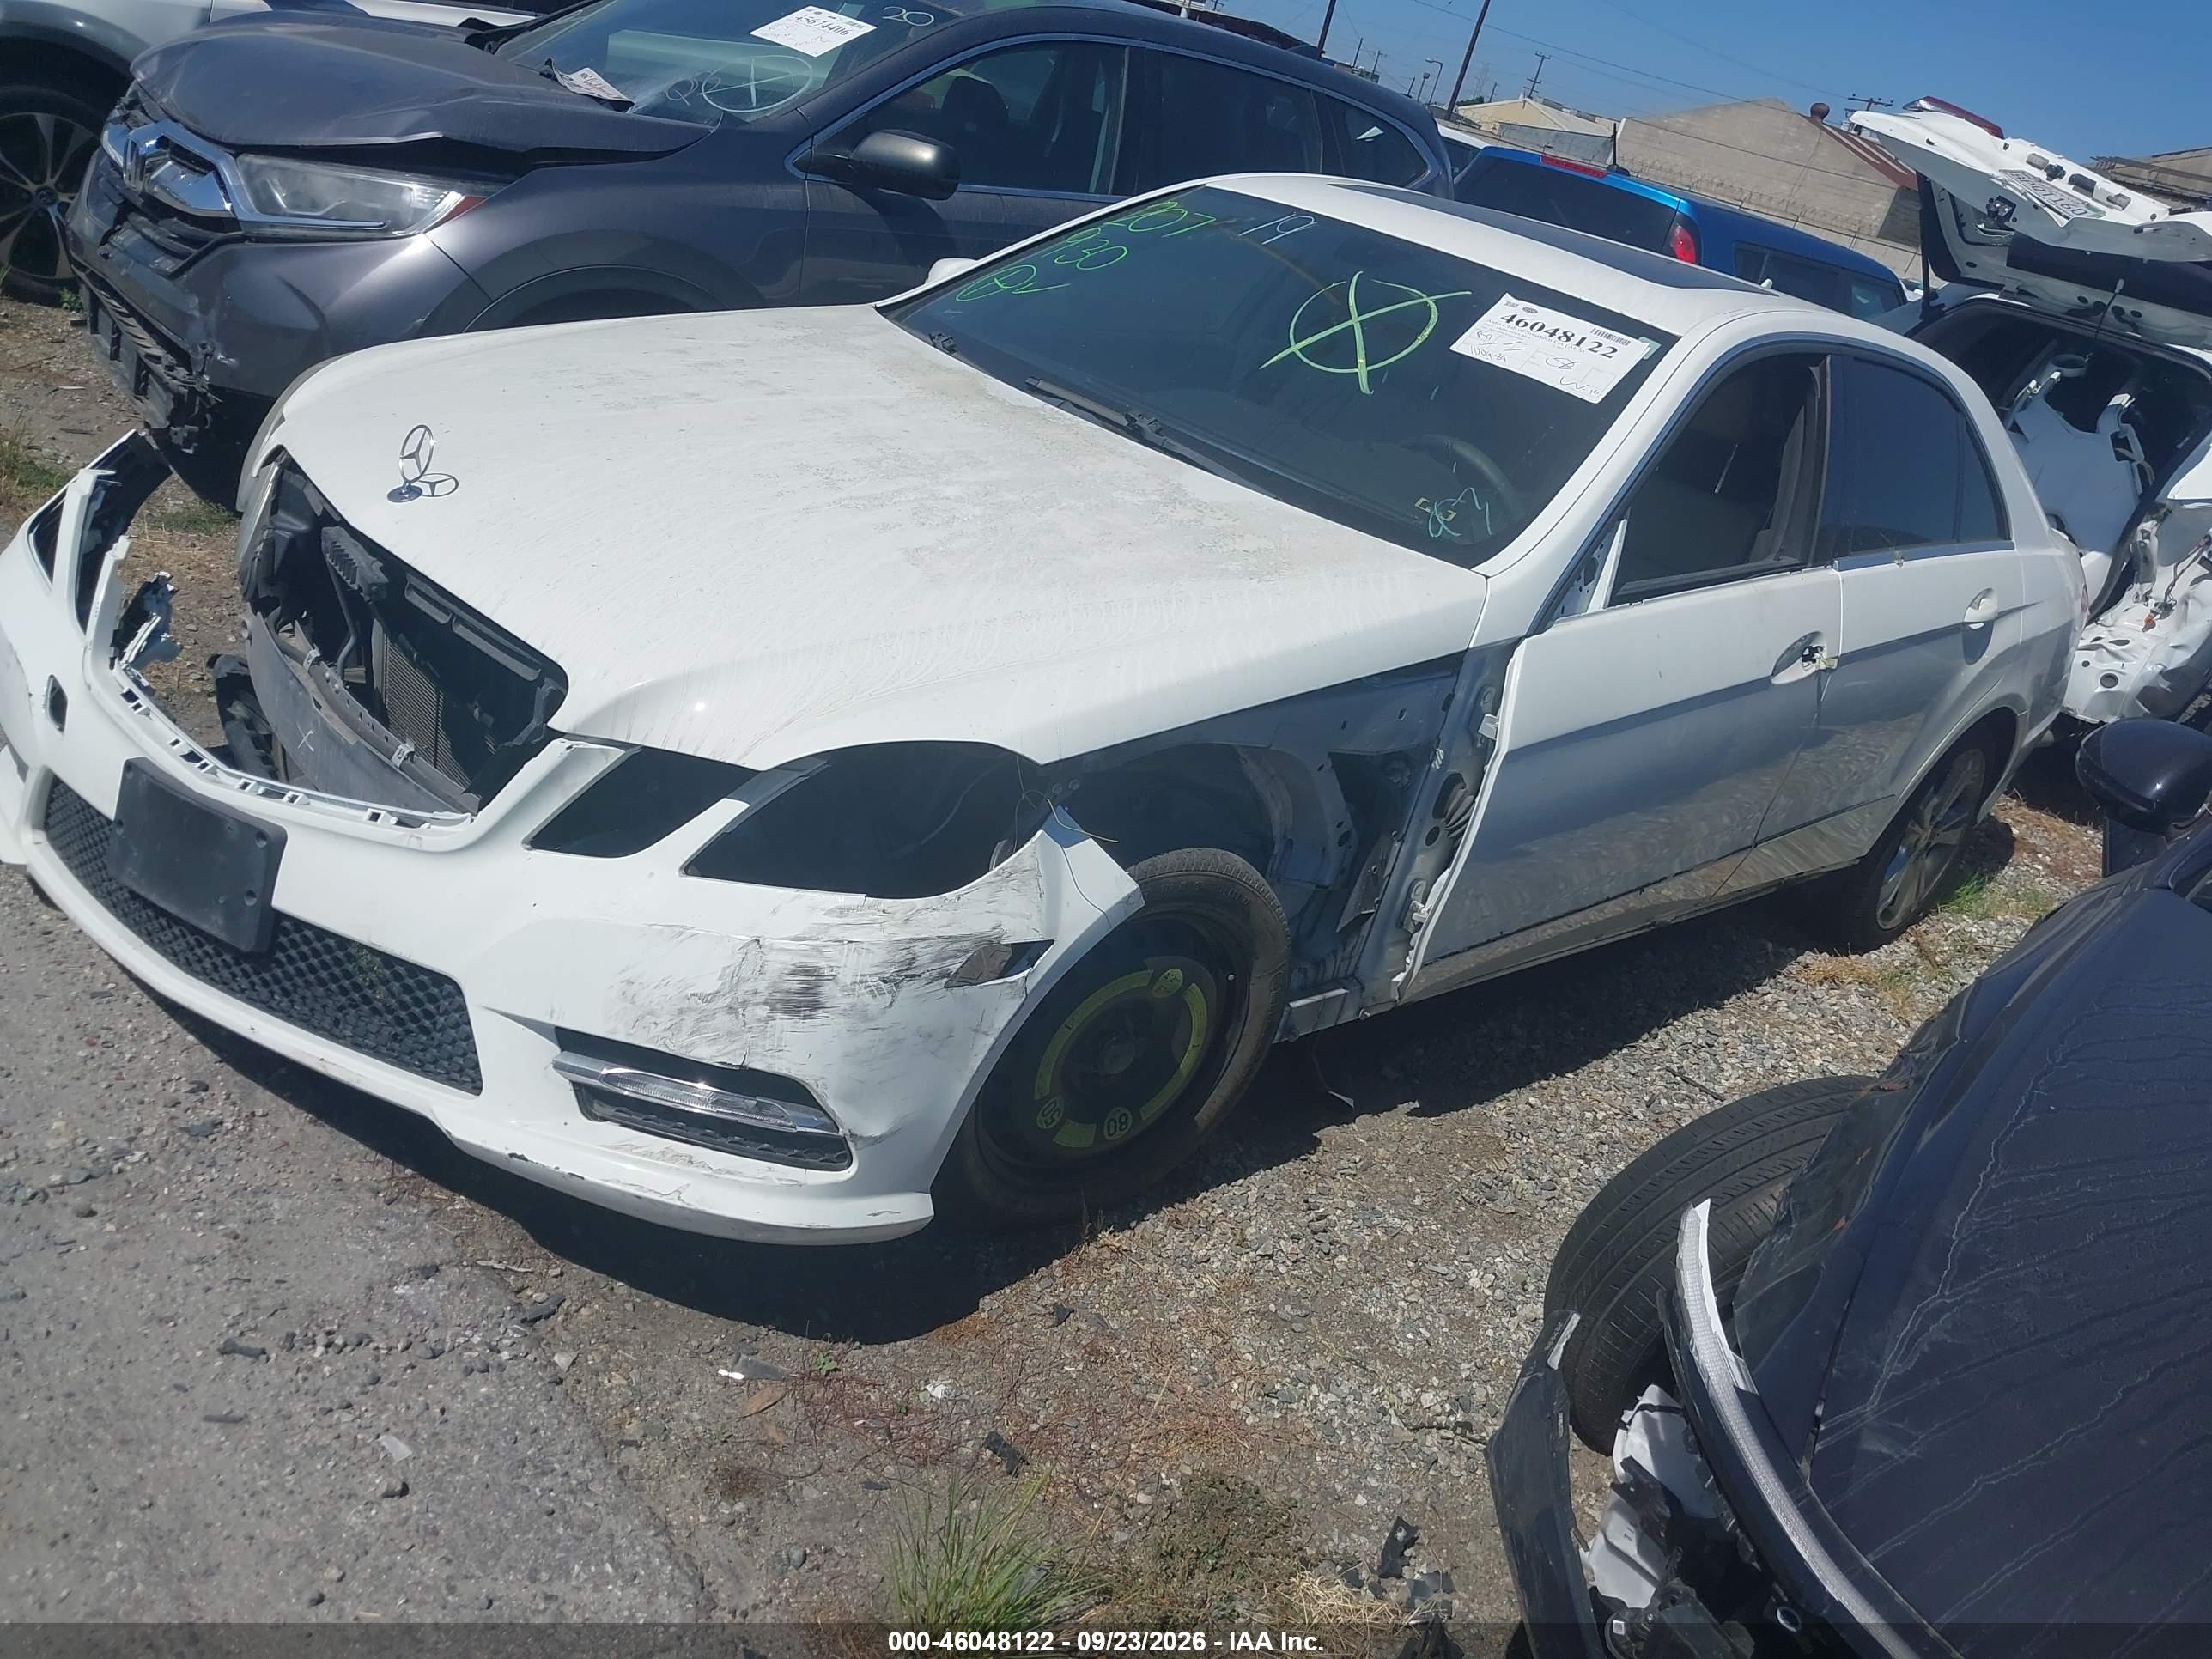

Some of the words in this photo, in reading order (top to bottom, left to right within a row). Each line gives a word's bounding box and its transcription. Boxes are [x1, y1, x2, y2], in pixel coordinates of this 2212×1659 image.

[881, 6, 935, 27] 20
[1500, 313, 1619, 359] 46048122
[1107, 1112, 1129, 1137] 80
